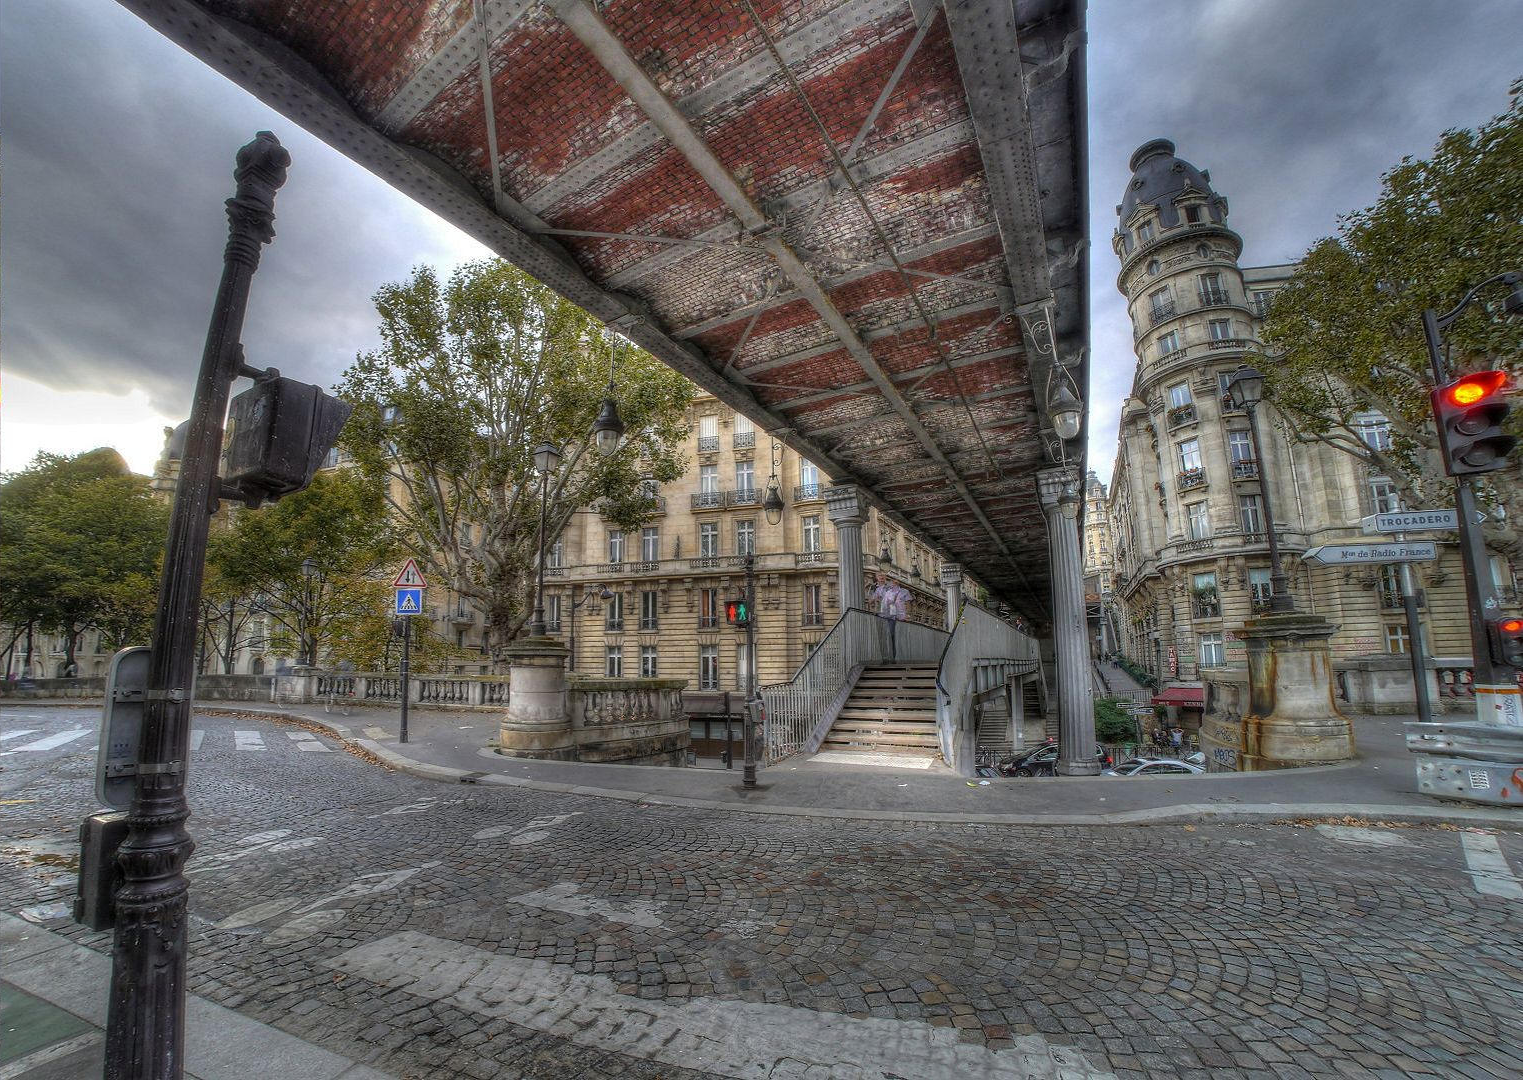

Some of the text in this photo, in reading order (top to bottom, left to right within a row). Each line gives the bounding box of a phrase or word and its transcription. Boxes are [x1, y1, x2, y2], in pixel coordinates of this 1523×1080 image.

[1358, 550, 1369, 558] de
[1371, 549, 1396, 558] Radio
[1399, 548, 1431, 557] France
